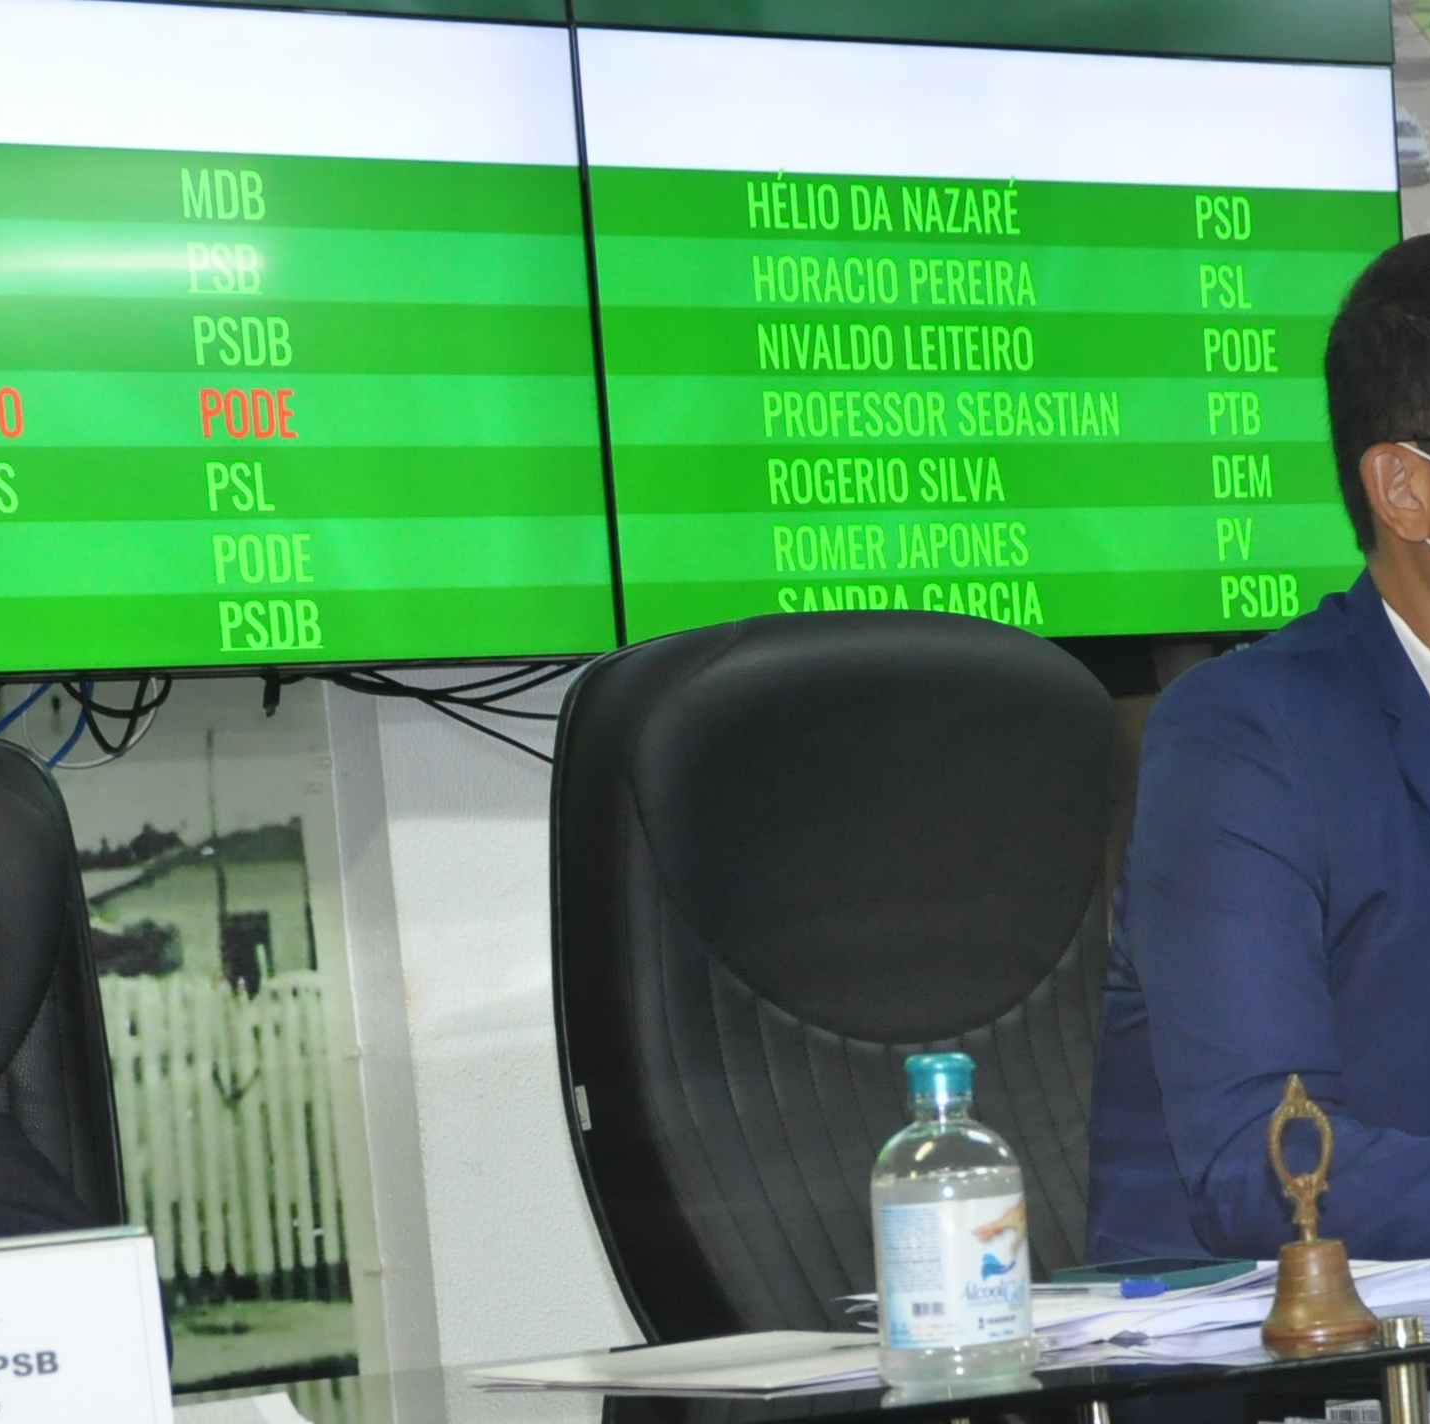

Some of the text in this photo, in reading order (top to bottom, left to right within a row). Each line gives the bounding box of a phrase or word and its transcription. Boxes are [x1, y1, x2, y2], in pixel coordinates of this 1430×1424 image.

[180, 168, 266, 220] MDB
[747, 168, 1020, 235] HÉLIO DA NAZARÉ
[1195, 194, 1252, 240] PSD
[186, 242, 262, 294] PSB
[752, 256, 1037, 306] HORACIO PEREIRA
[1199, 264, 1253, 309] PSL
[192, 315, 293, 366] PSDB
[757, 323, 1035, 371] NIVALDO LEITEIRO
[1203, 327, 1279, 372] PODE
[199, 388, 299, 438] PODE
[763, 391, 1121, 437] PROFESSOR SEBASTIAN
[1207, 391, 1262, 436] PTB
[205, 462, 276, 512] PSL
[768, 456, 1006, 504] ROGERIO SILVA
[1211, 454, 1273, 499] DEM
[212, 533, 315, 585] PODE
[774, 521, 1030, 572] ROMER JAPONES
[1217, 518, 1253, 562] PV
[922, 580, 1045, 626] GARCIA
[1220, 573, 1300, 619] PSDB
[218, 599, 322, 651] PSDB
